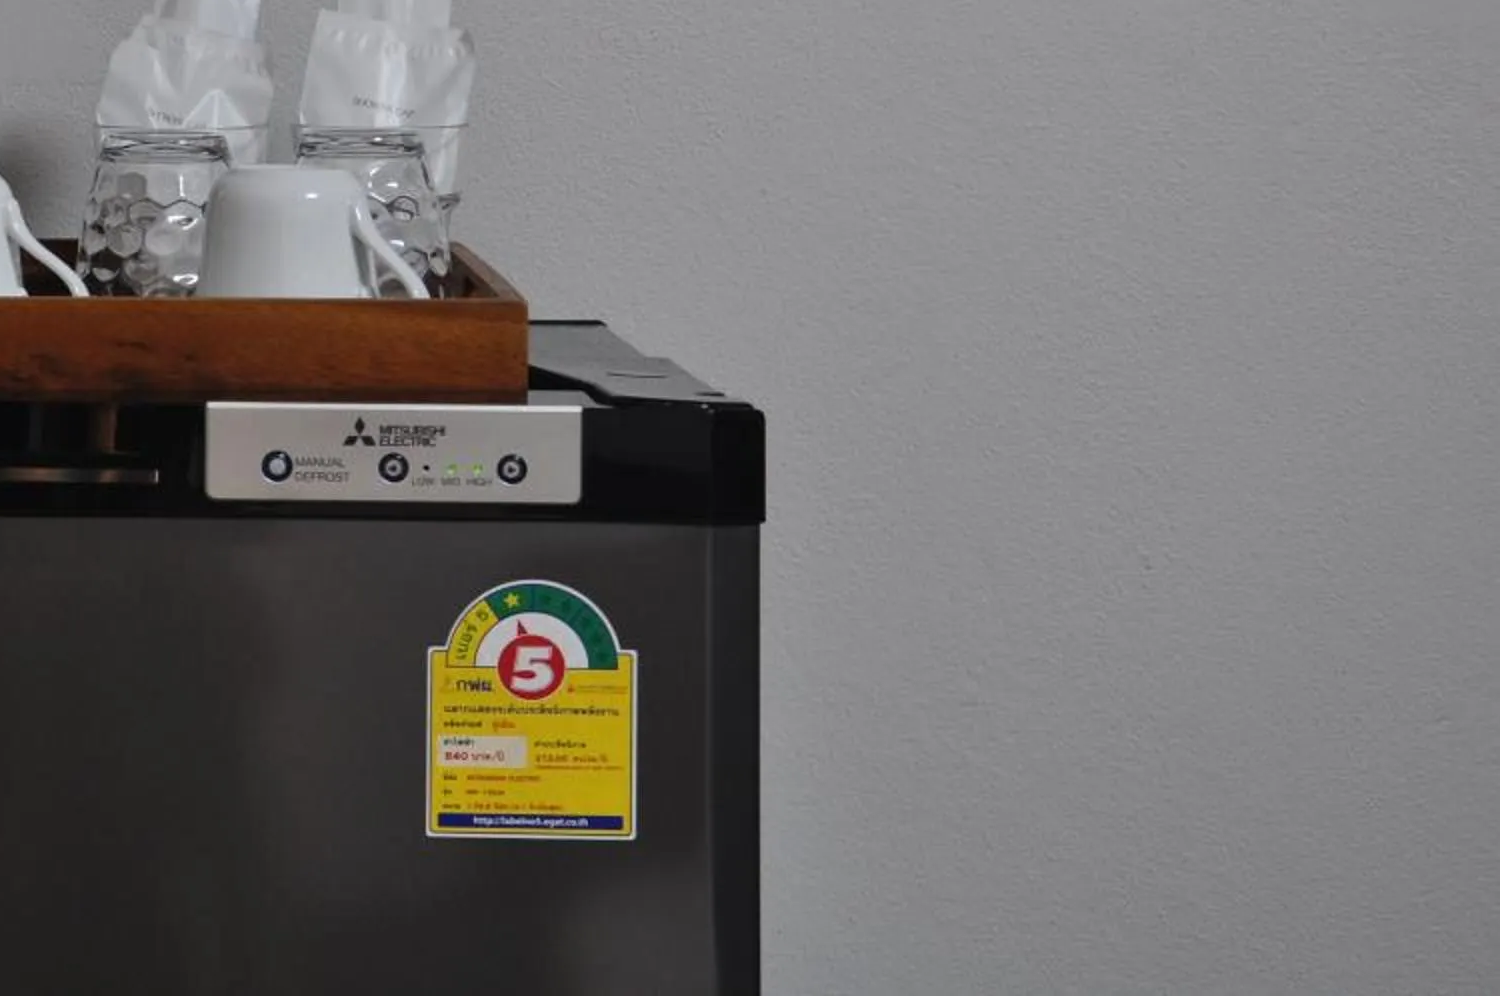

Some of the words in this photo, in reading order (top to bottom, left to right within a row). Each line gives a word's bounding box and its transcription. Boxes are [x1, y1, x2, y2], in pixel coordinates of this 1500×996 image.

[380, 426, 446, 436] MITSUBISHI
[380, 436, 437, 446] ELECTRIC
[295, 457, 345, 468] MANUAL
[295, 471, 349, 482] DEFROST
[510, 644, 555, 693] 5
